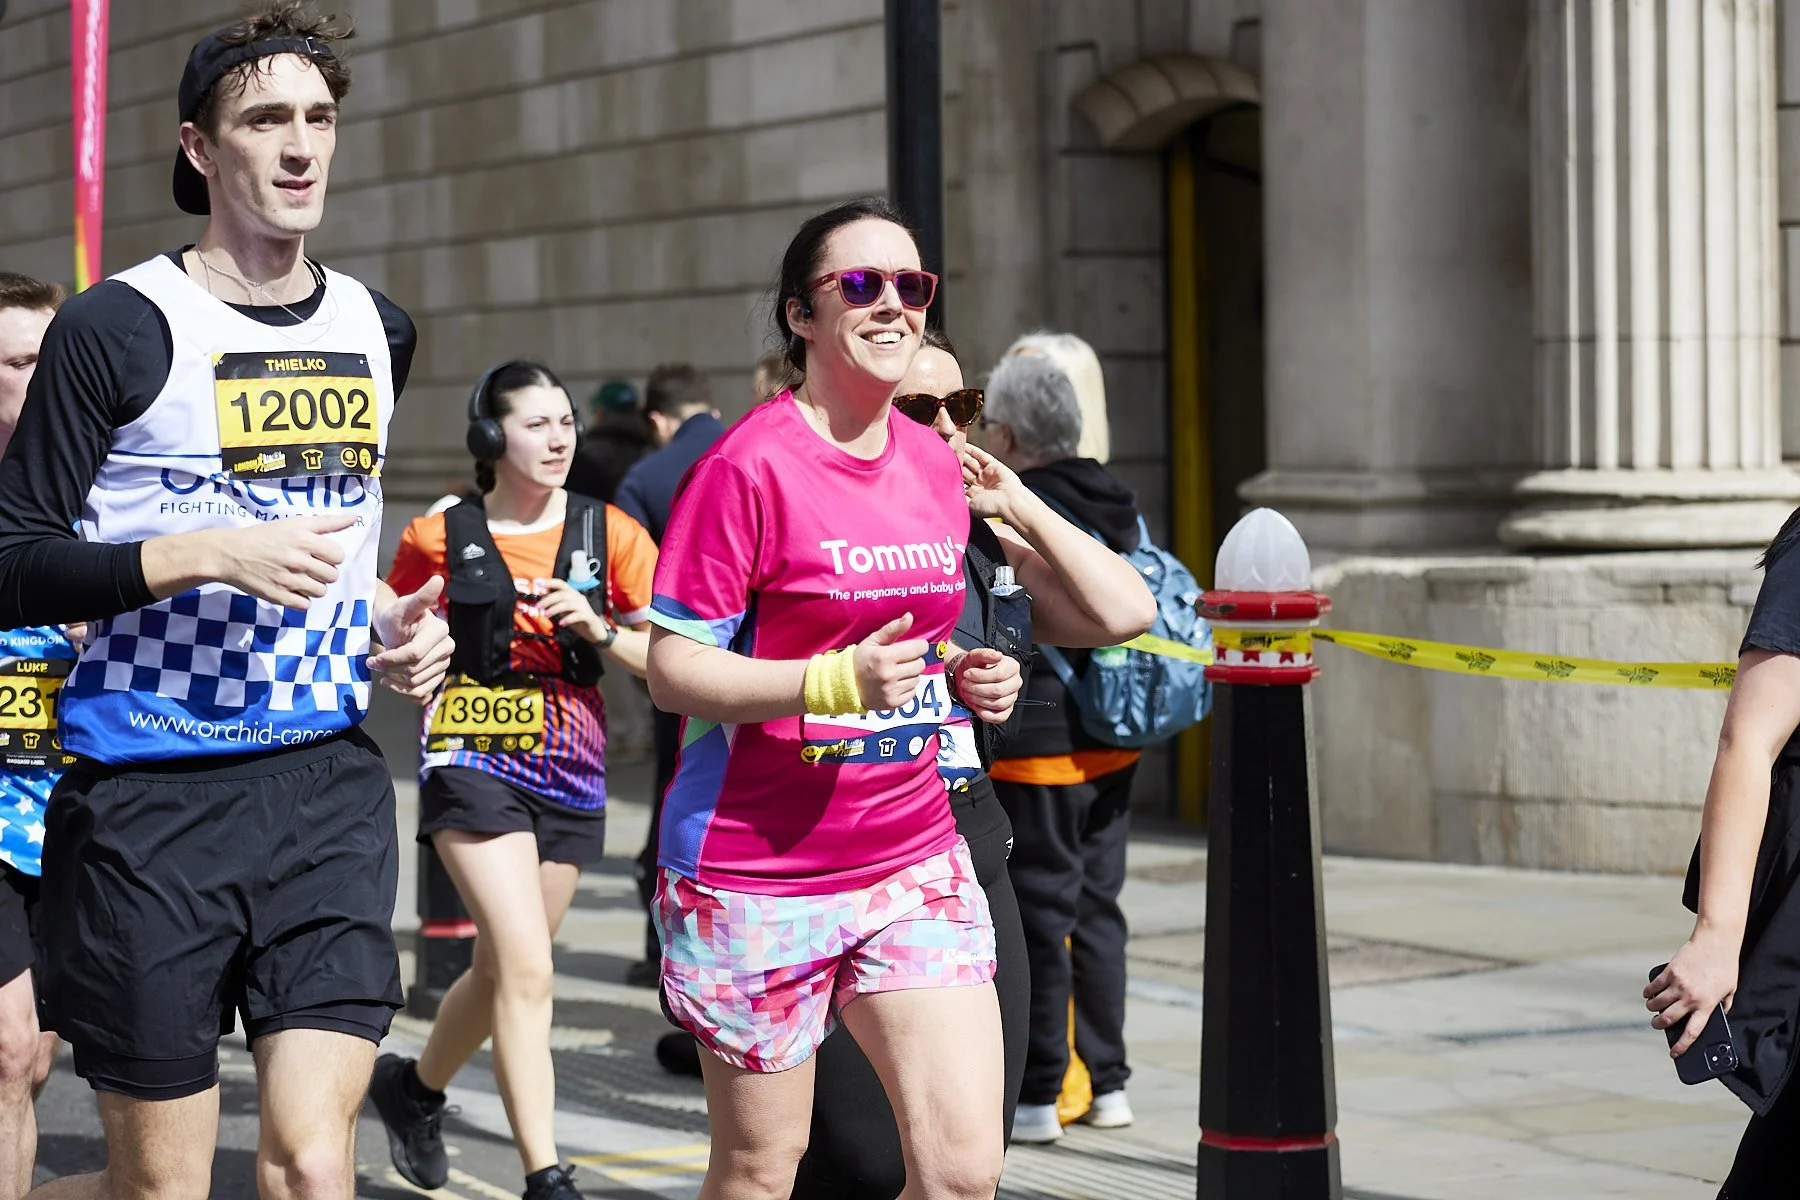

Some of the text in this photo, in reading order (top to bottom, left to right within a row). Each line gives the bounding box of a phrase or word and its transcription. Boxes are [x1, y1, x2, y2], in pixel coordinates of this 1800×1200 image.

[265, 358, 327, 371] THIELKO
[230, 388, 371, 433] 12002
[160, 502, 247, 518] FIGHTING
[827, 588, 851, 601] The
[853, 585, 908, 602] pregnancy
[909, 582, 929, 595] and
[930, 581, 954, 594] baby
[10, 634, 66, 648] KINGDOM
[16, 661, 49, 673] LUKE
[440, 696, 535, 724] 13968
[128, 711, 342, 746] www.orchid-cance
